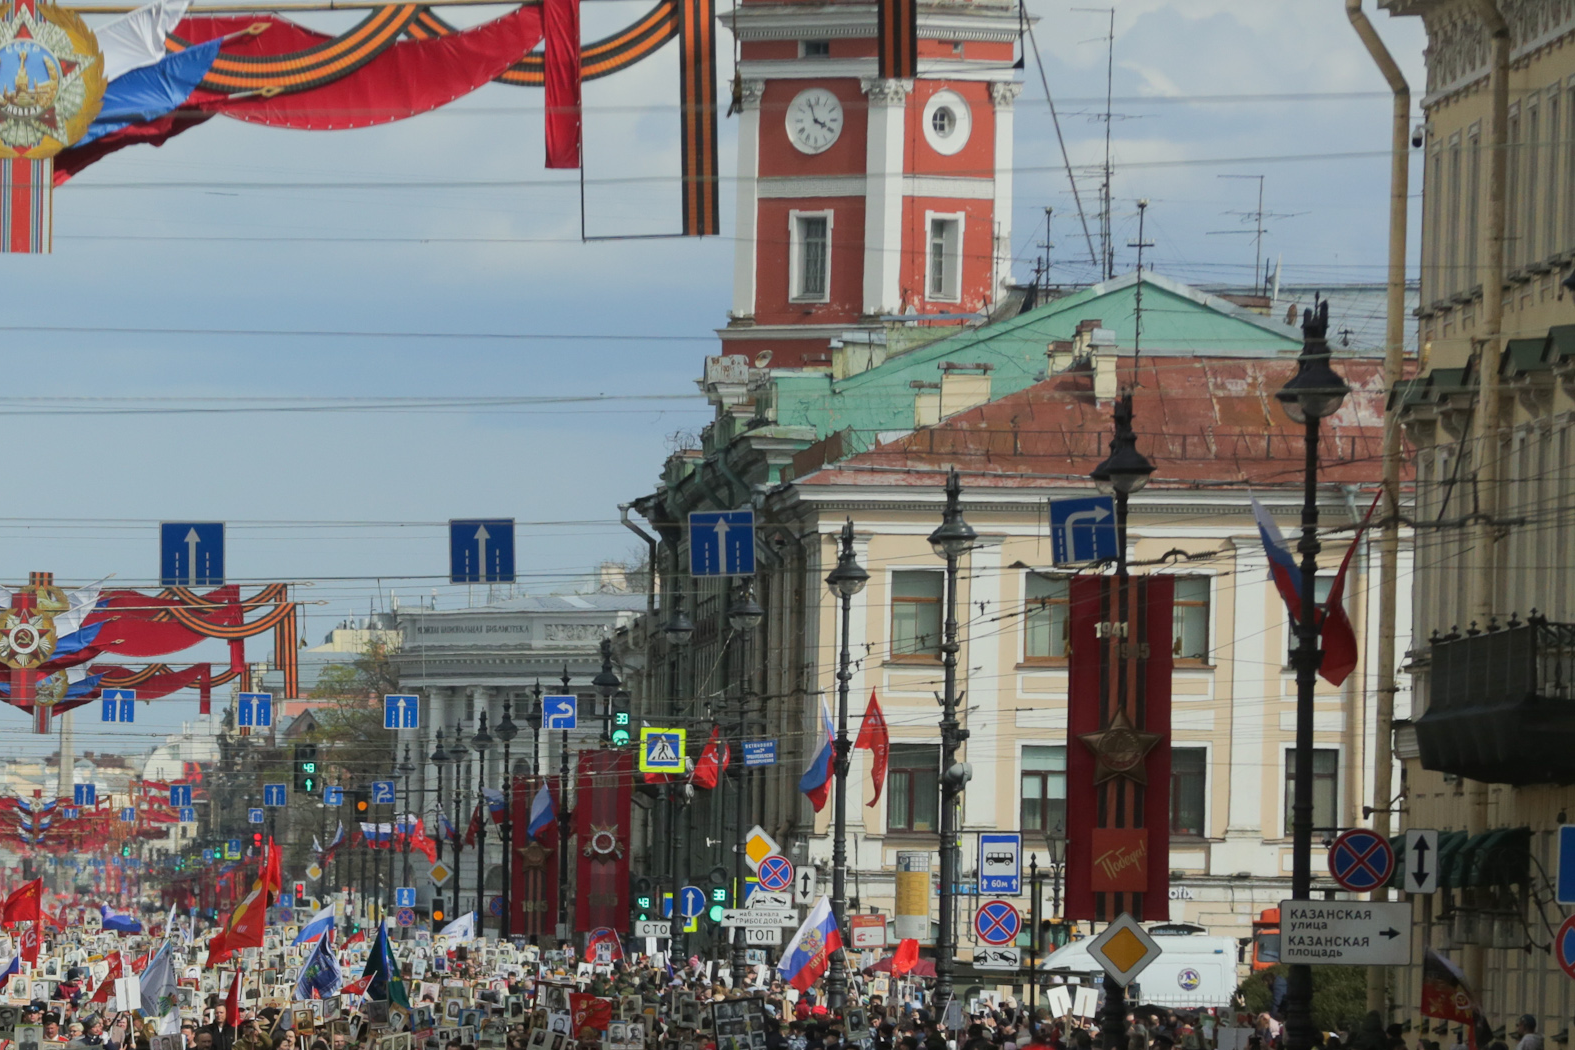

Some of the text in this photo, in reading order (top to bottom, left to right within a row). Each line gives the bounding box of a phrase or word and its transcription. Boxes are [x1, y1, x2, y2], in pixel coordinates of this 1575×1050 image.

[1094, 622, 1128, 638] 1941
[1114, 643, 1150, 659] 1945
[1094, 840, 1146, 880] Победа!
[991, 879, 1008, 888] 60м
[1169, 886, 1194, 900] ofix
[1290, 909, 1372, 920] КАЗАНСКАЯ
[735, 917, 783, 925] ГРИБОЕДОВА
[1291, 921, 1328, 932] улица
[643, 924, 668, 934] СТО
[747, 930, 774, 941] ТОП
[1288, 936, 1370, 947] КАЗАНСКАЯ
[1288, 948, 1343, 958] площадь
